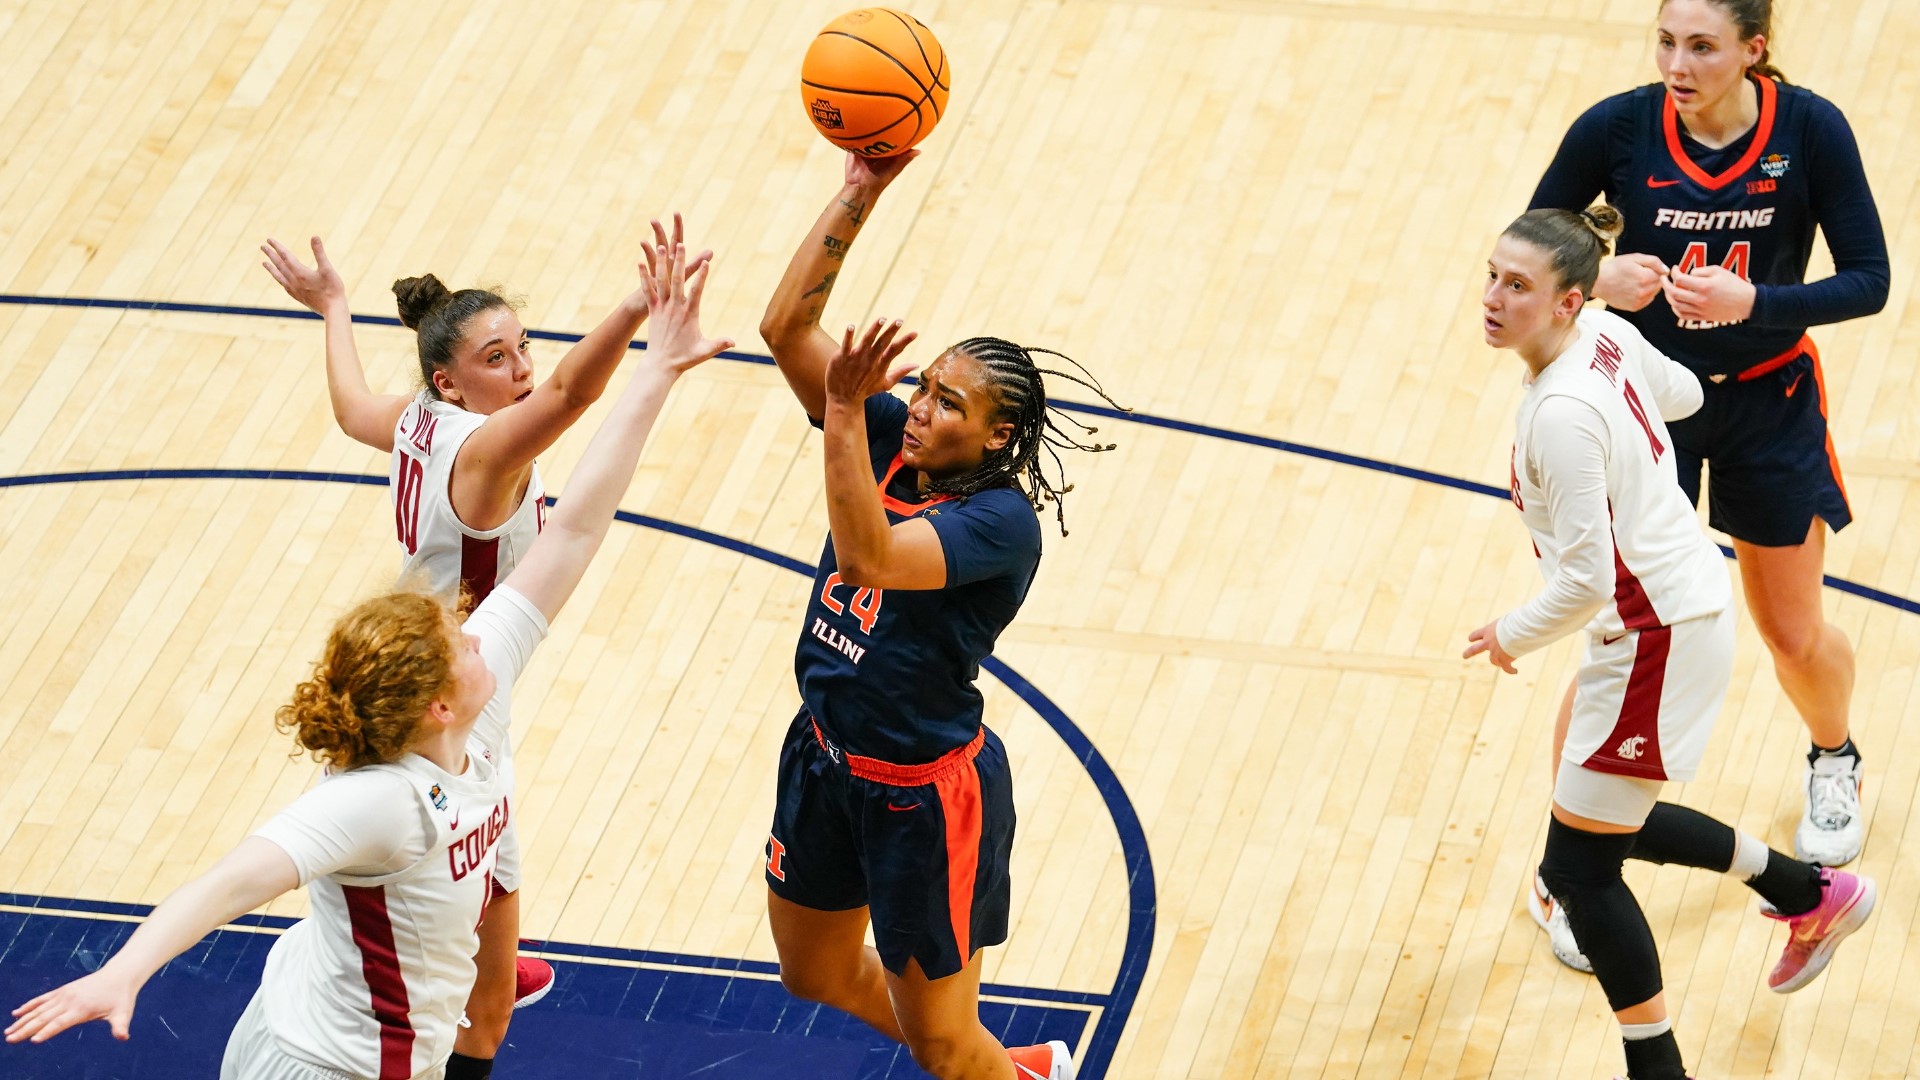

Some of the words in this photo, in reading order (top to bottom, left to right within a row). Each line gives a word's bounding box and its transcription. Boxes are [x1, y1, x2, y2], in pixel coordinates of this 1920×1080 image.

[1654, 207, 1776, 230] FIGHTING
[395, 448, 424, 557] 10
[820, 571, 883, 636] 24
[811, 616, 867, 665] ILLINI
